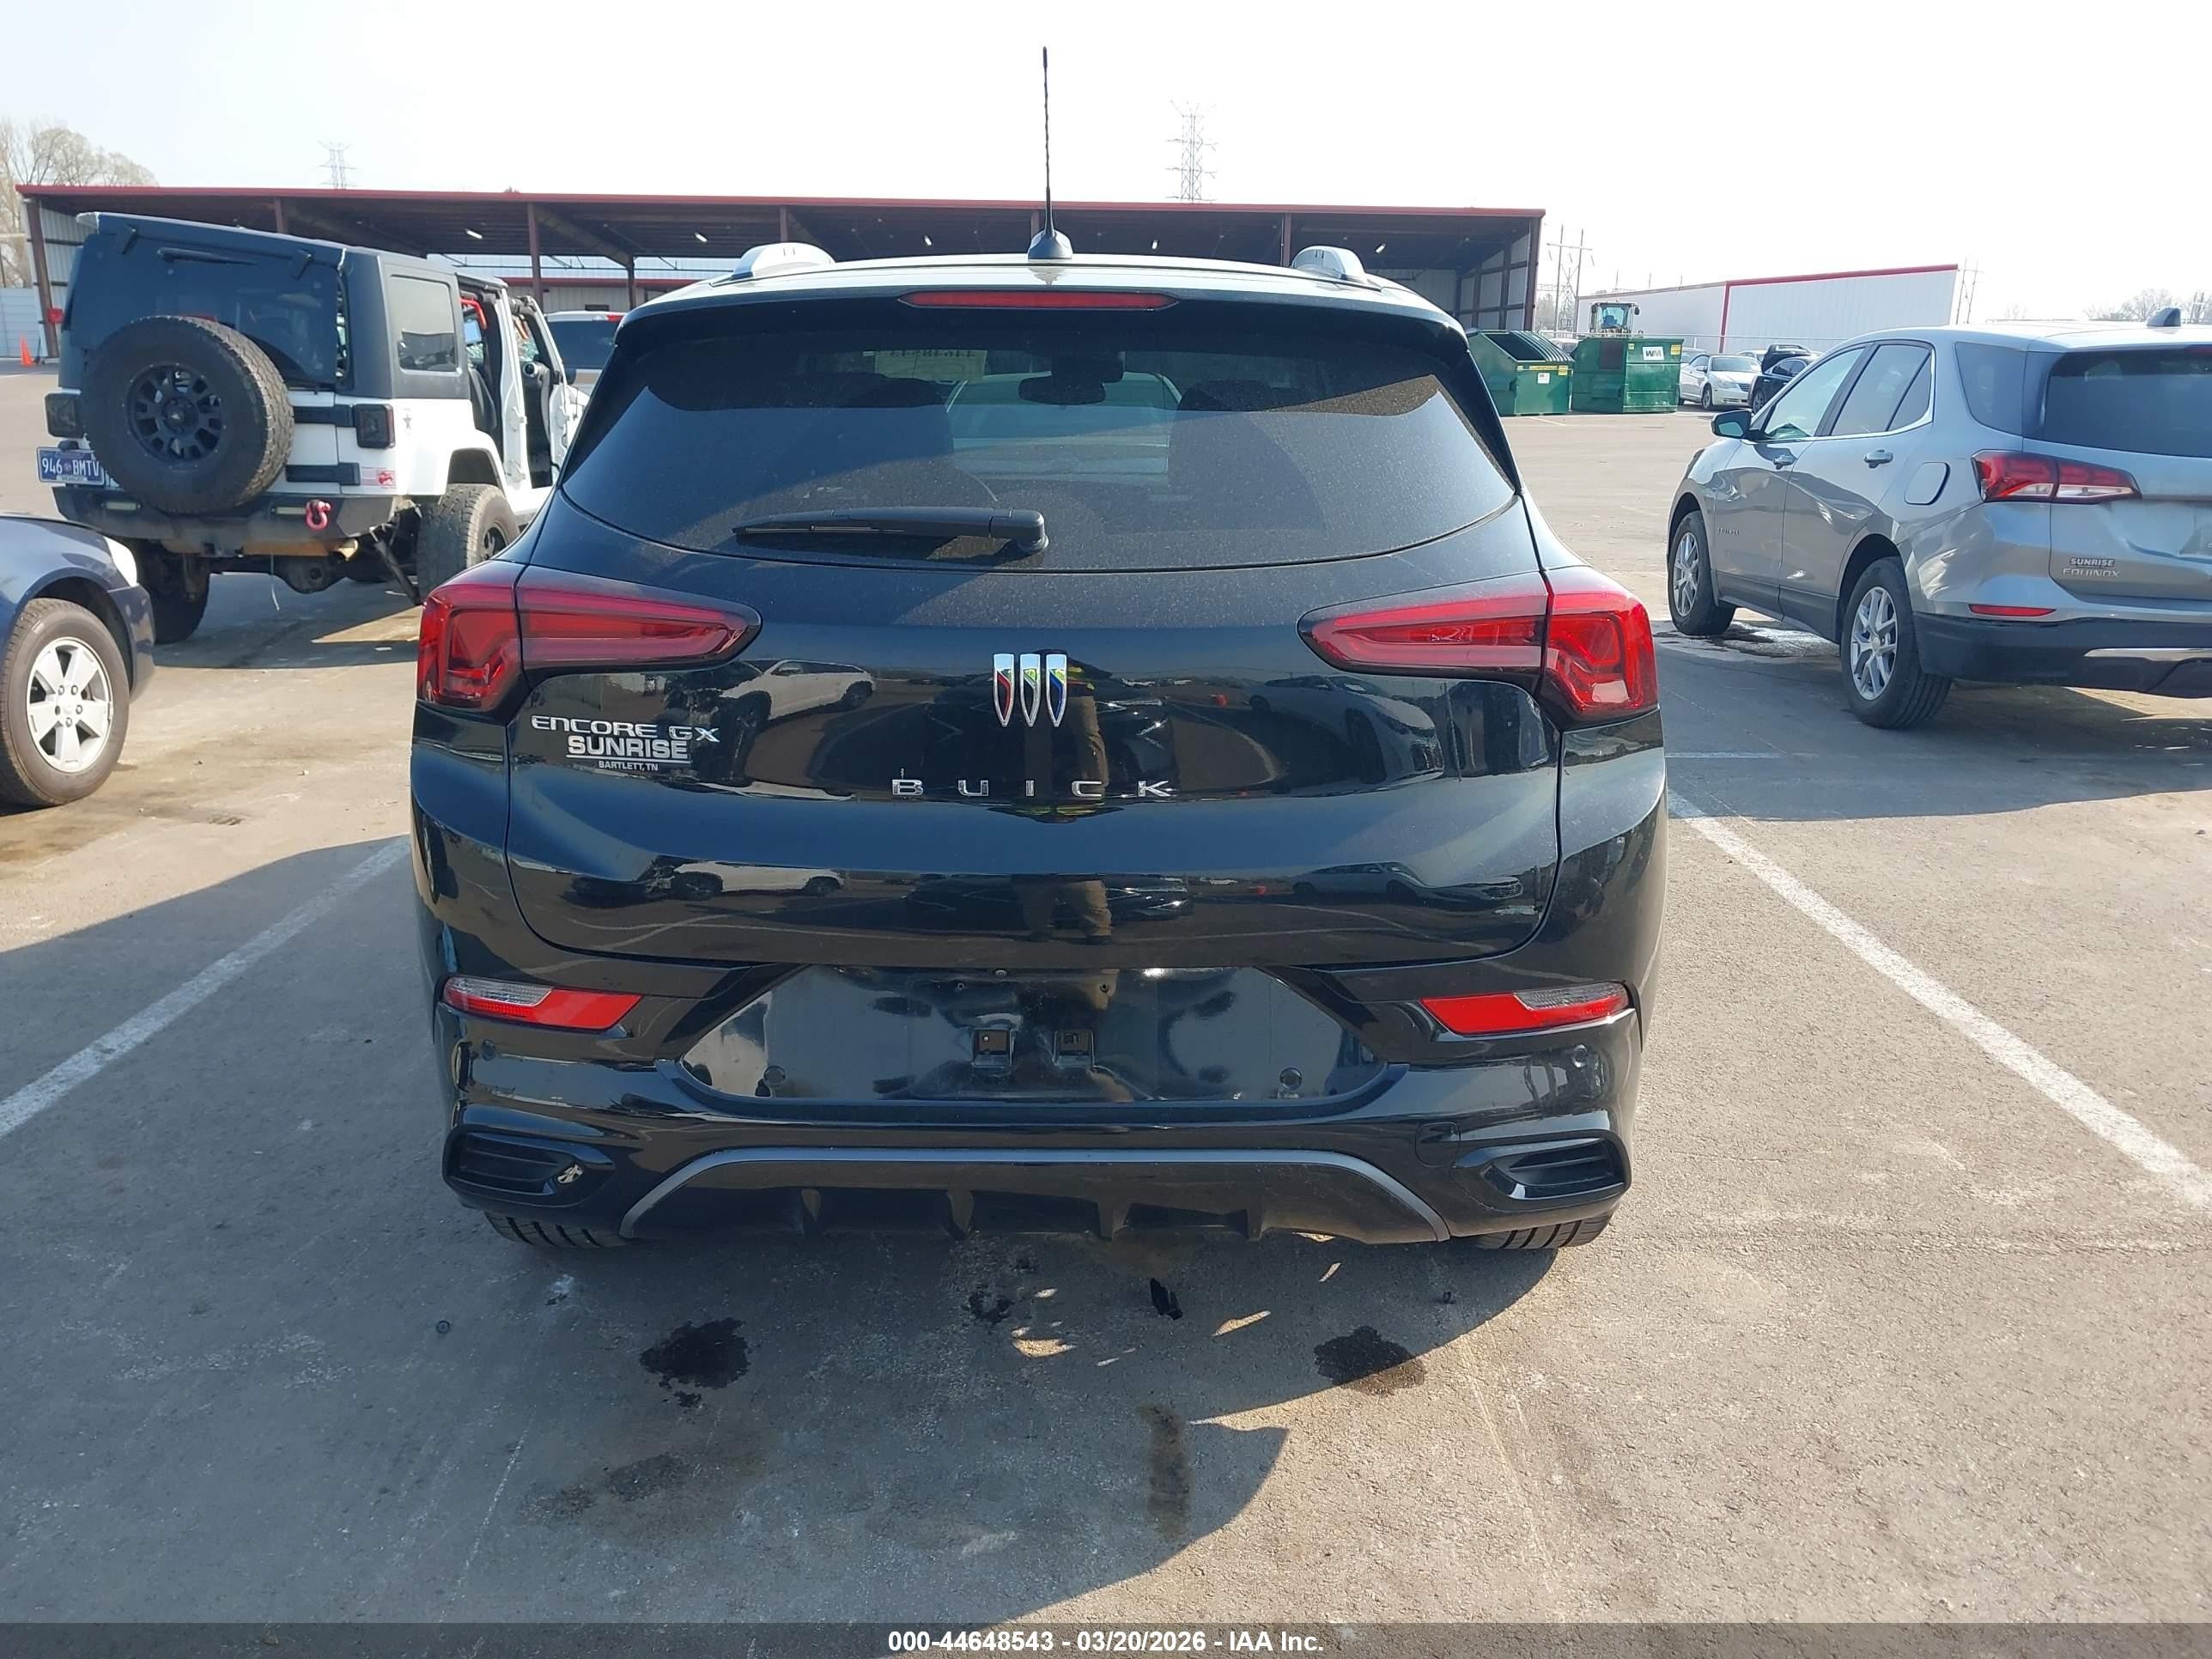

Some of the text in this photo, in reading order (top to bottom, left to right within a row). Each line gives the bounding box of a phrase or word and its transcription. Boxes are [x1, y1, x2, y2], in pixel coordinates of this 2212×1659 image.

[41, 457, 100, 477] 946 BMTV
[2070, 557, 2115, 567] SUNRISE
[2063, 568, 2120, 577] EQUINOX
[532, 715, 720, 743] ENCORE GX
[568, 735, 688, 759] SUNRISE
[599, 760, 659, 772] BARTLETT, TN
[891, 779, 1173, 798] BUICK
